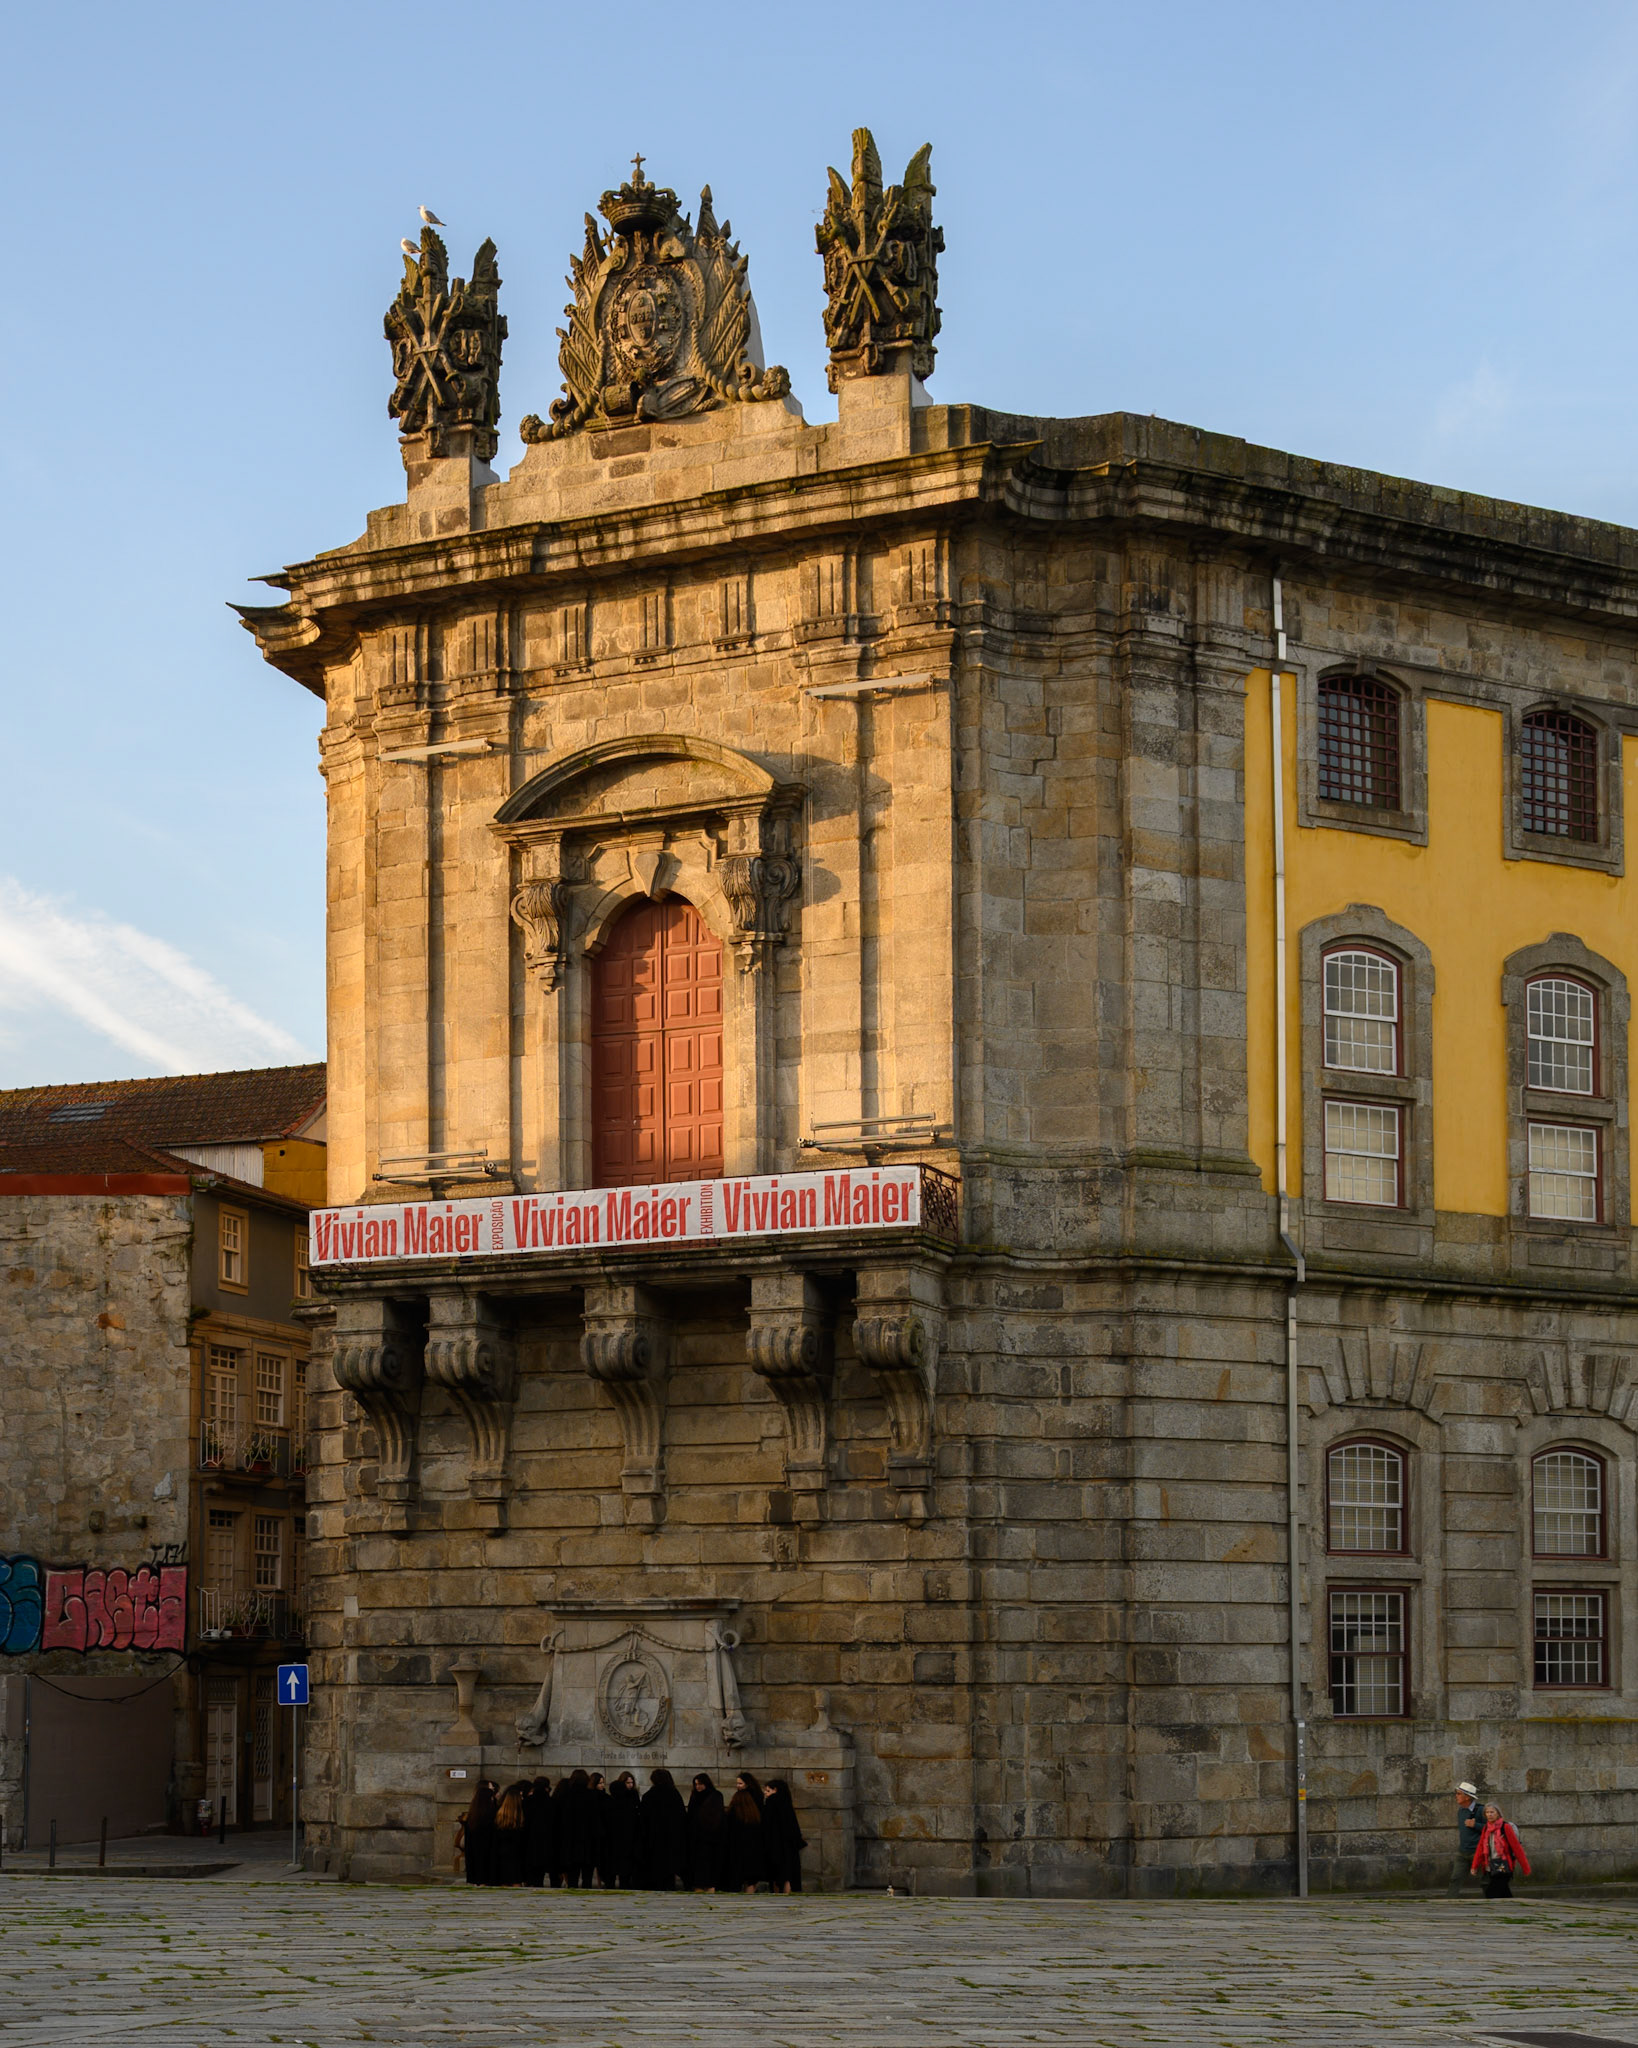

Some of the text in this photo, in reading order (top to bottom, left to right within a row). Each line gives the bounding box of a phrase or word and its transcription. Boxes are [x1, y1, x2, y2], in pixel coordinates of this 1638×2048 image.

[491, 1201, 504, 1250] EXPOSIÇÃO
[512, 1189, 691, 1249] Vivian Maier
[700, 1184, 714, 1235] EXHIBITION
[723, 1172, 914, 1232] Vivian Maier
[315, 1205, 484, 1261] Vivian Maier
